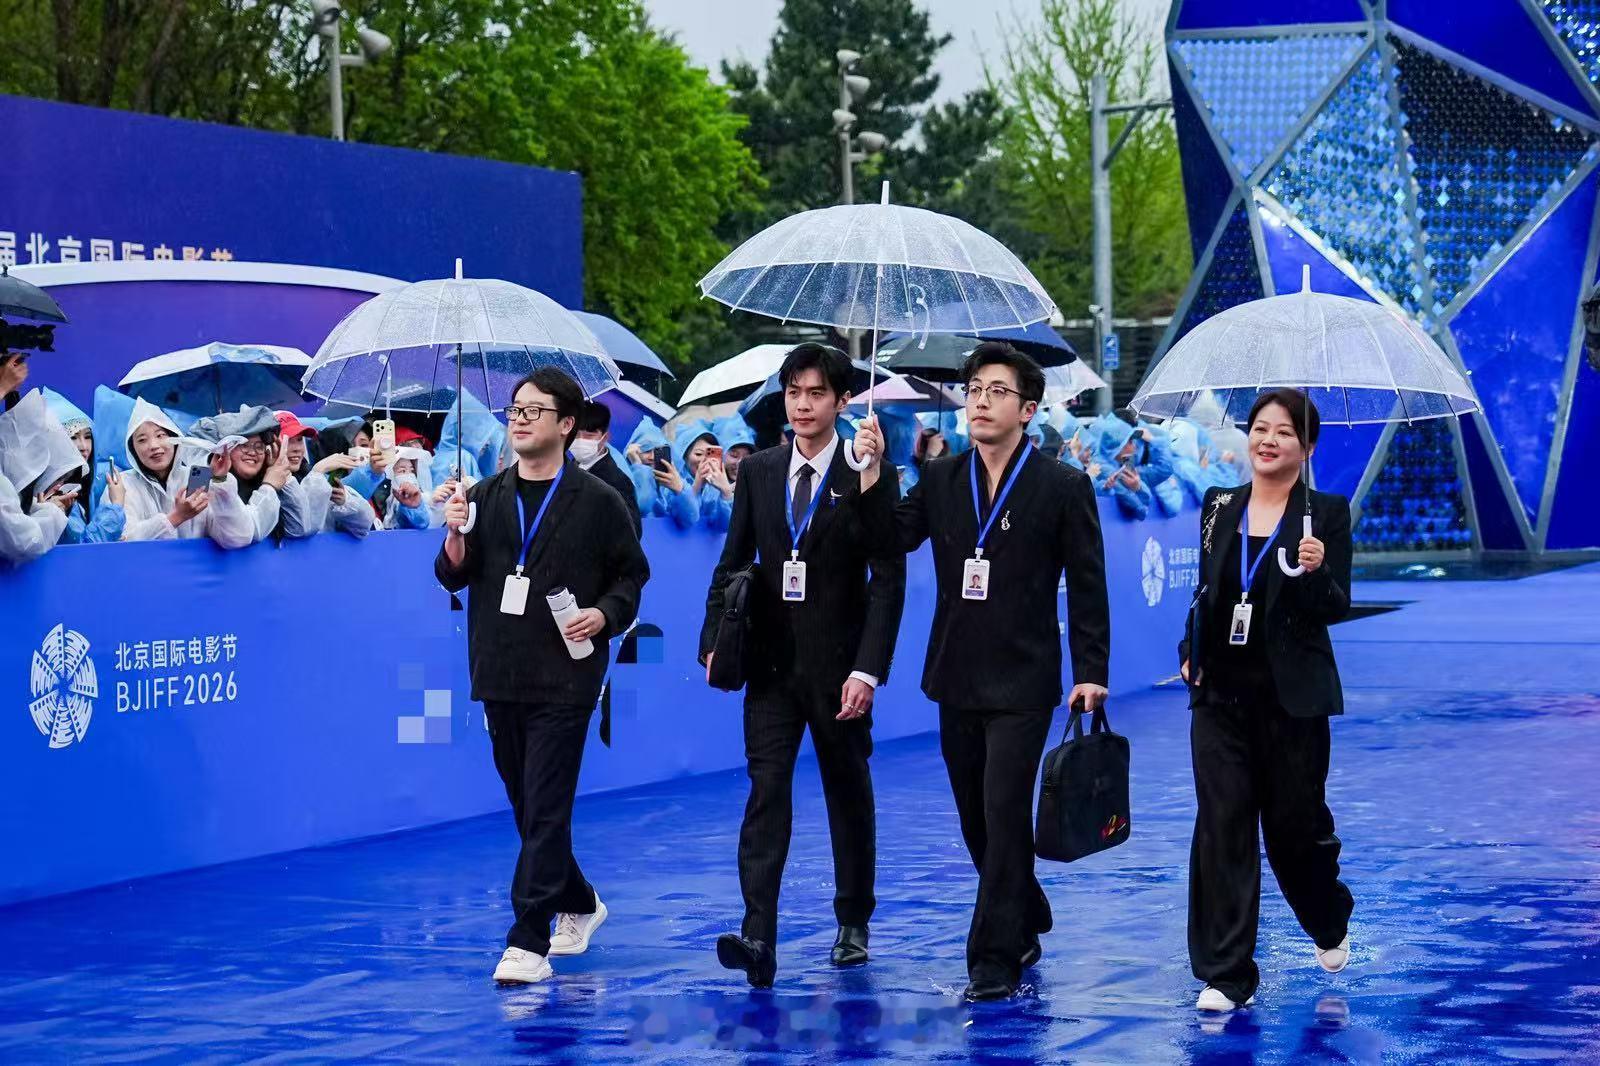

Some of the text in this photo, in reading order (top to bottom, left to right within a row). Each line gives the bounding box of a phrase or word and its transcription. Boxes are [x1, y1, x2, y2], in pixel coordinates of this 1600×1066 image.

[115, 633, 237, 671] 北京国际电影节
